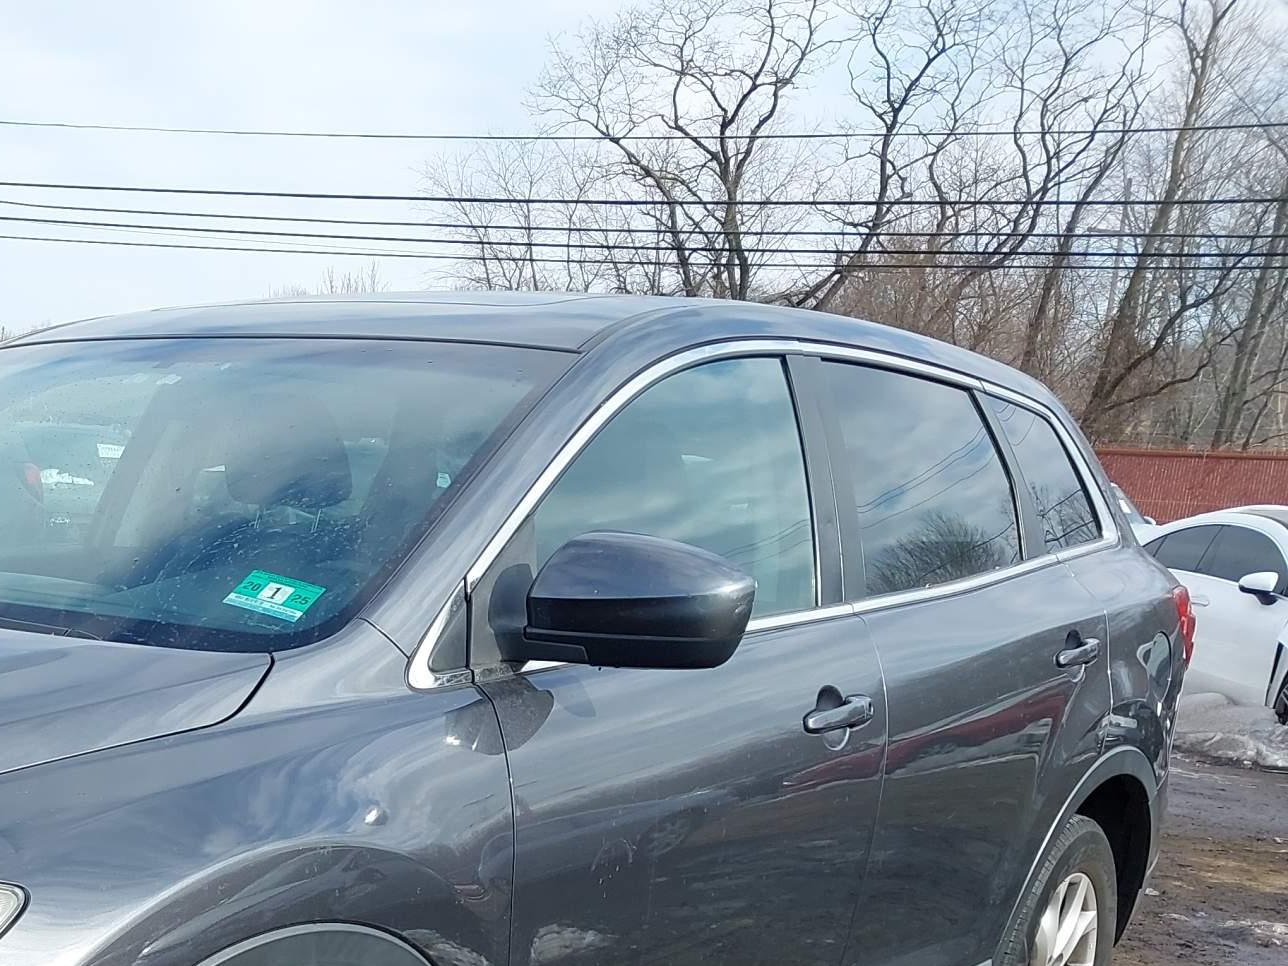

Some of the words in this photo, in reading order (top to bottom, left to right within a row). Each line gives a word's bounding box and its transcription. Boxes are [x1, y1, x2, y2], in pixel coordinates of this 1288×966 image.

[243, 582, 261, 592] 20
[267, 587, 282, 599] 1
[290, 594, 311, 605] 25
